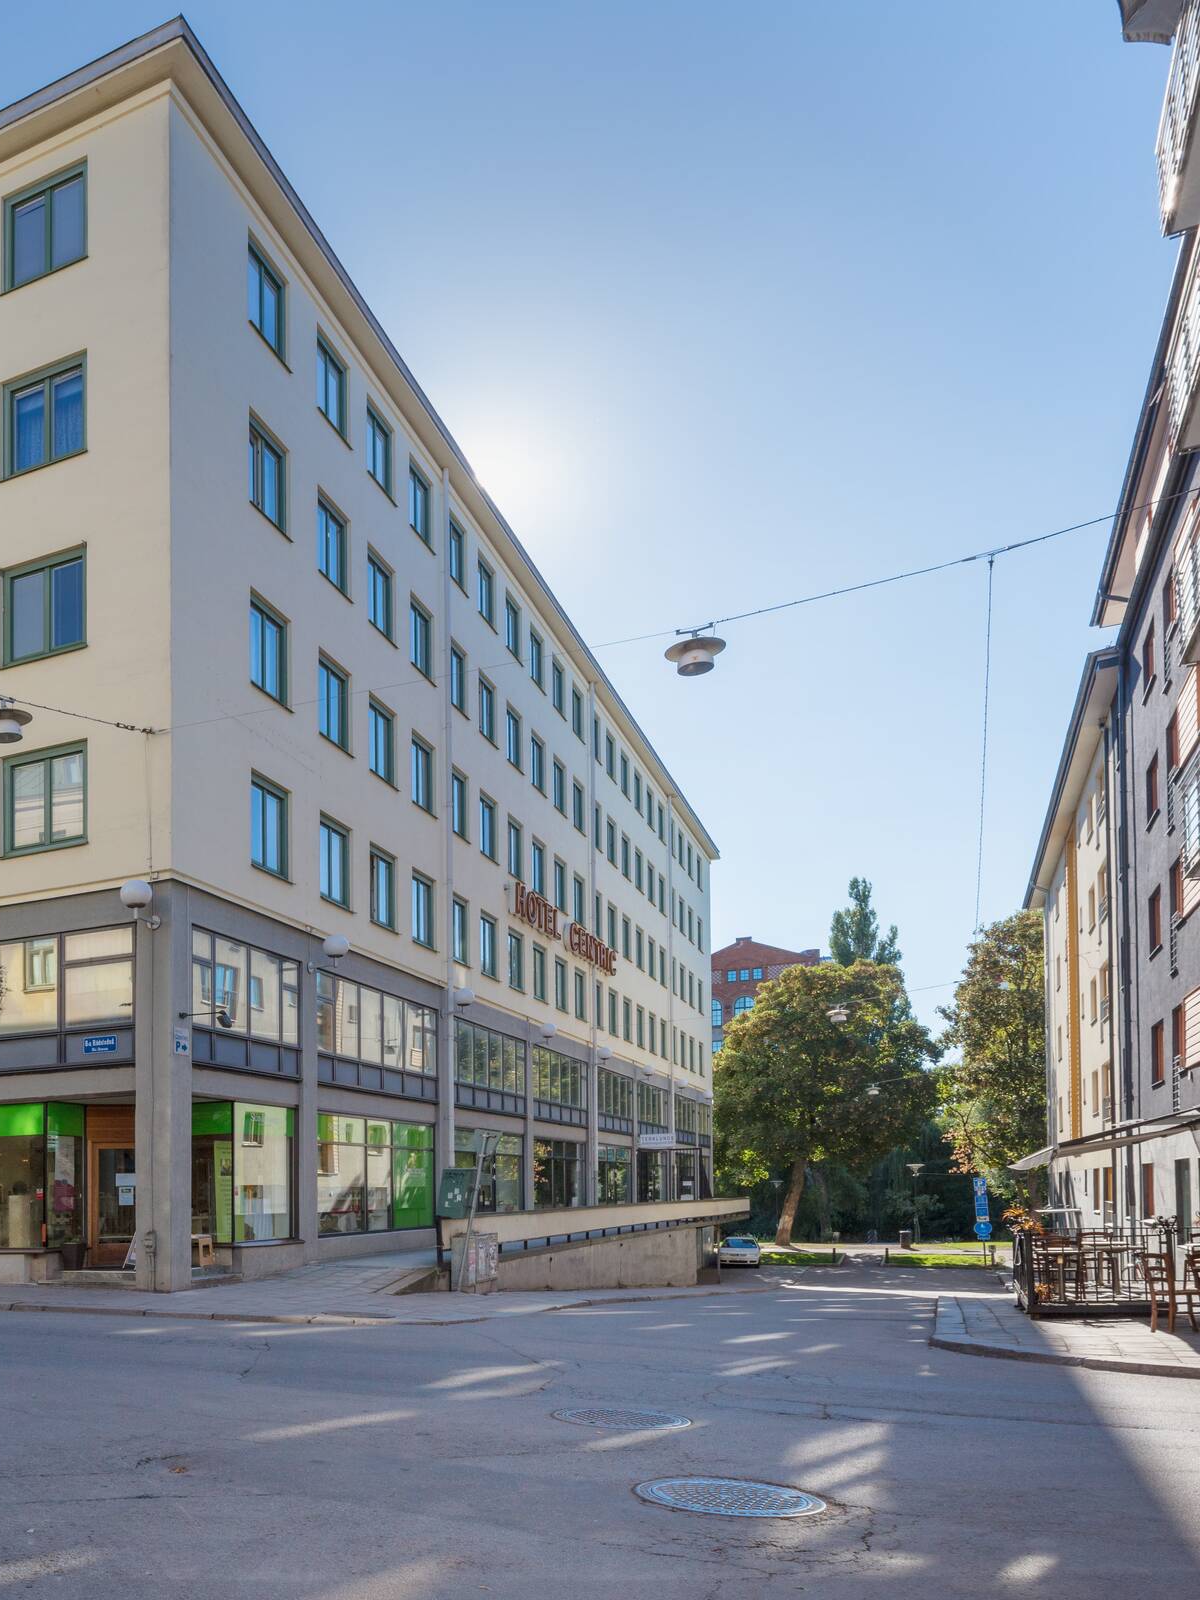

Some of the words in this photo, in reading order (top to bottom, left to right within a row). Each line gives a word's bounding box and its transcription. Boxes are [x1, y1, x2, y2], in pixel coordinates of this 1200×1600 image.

[515, 882, 561, 940] HOTEL
[569, 922, 616, 977] CENTRIC
[175, 1041, 181, 1052] P
